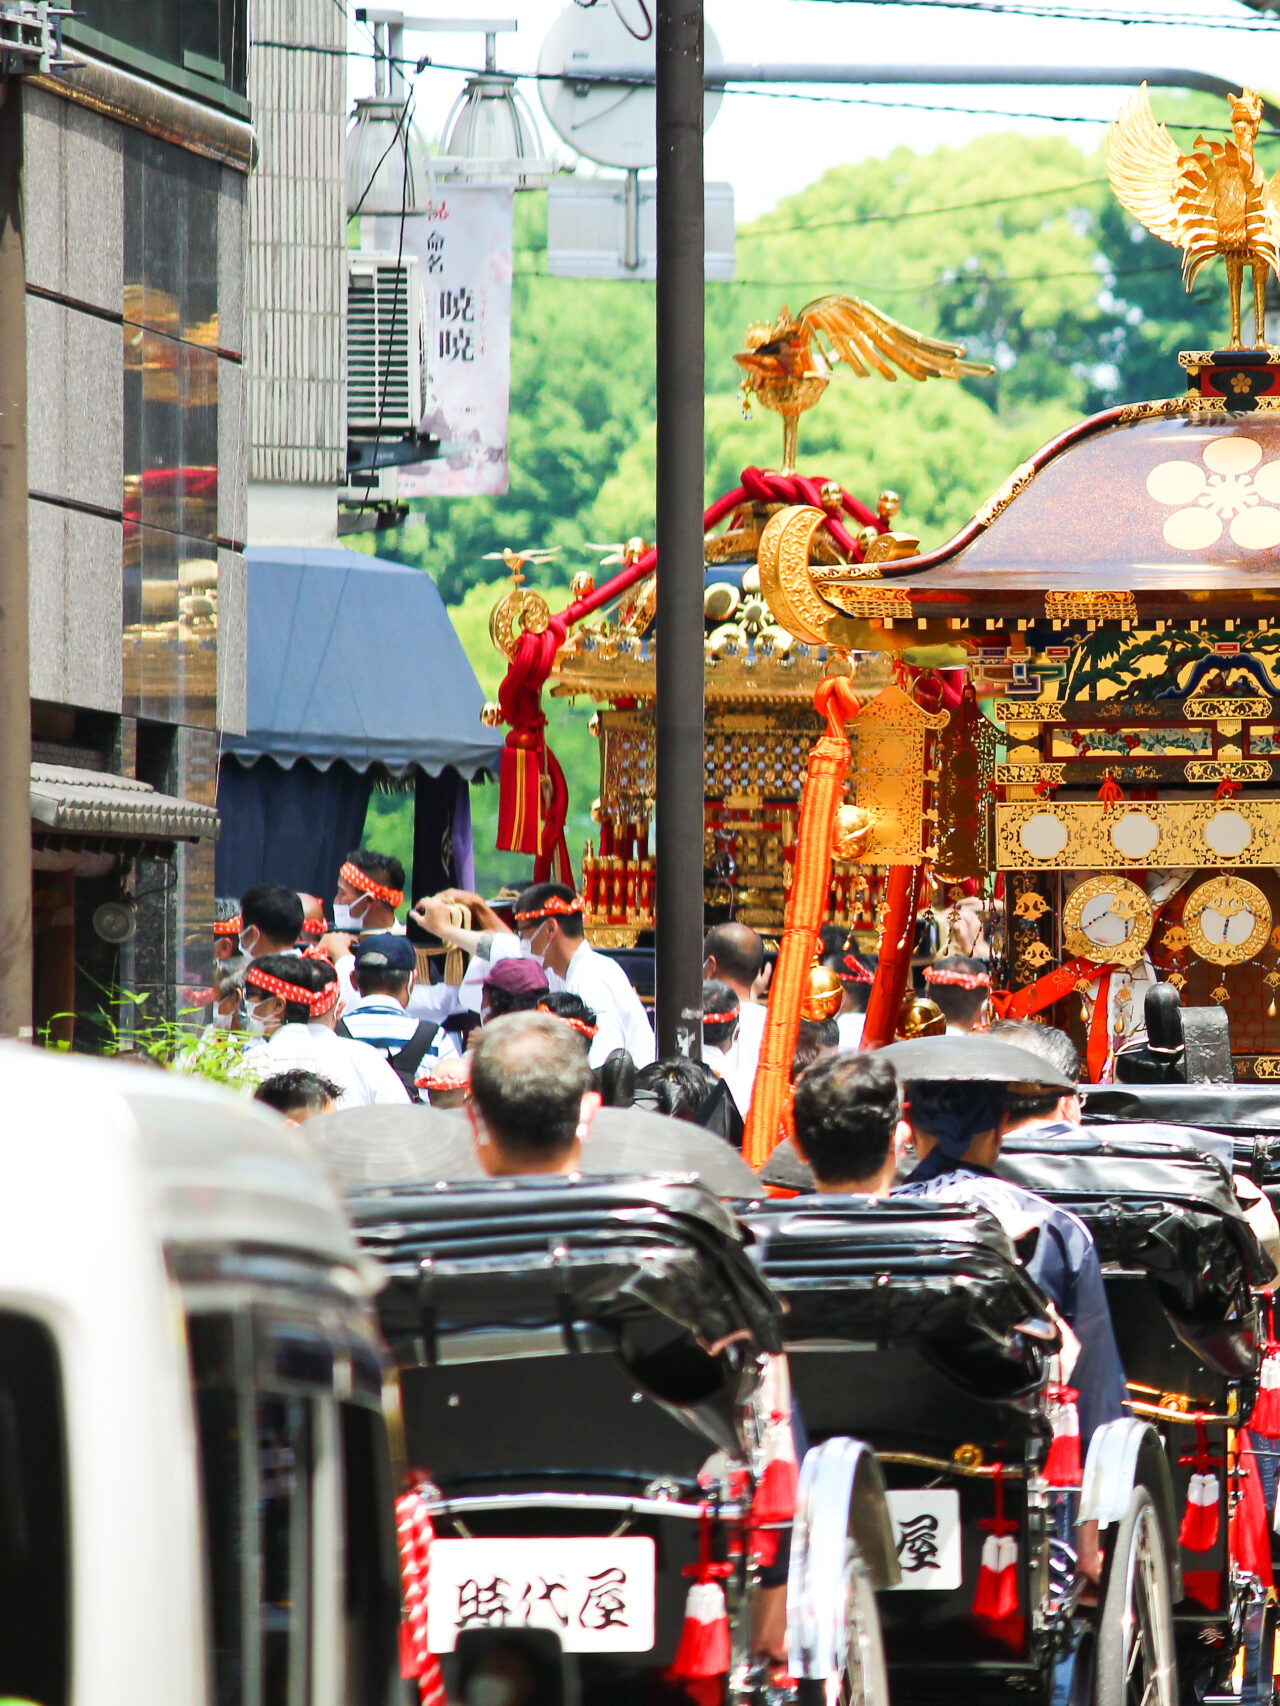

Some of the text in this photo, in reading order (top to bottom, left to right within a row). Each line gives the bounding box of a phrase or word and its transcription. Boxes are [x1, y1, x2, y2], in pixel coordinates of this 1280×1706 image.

[439, 287, 475, 362] 暁暁
[455, 1567, 629, 1629] 時代屋
